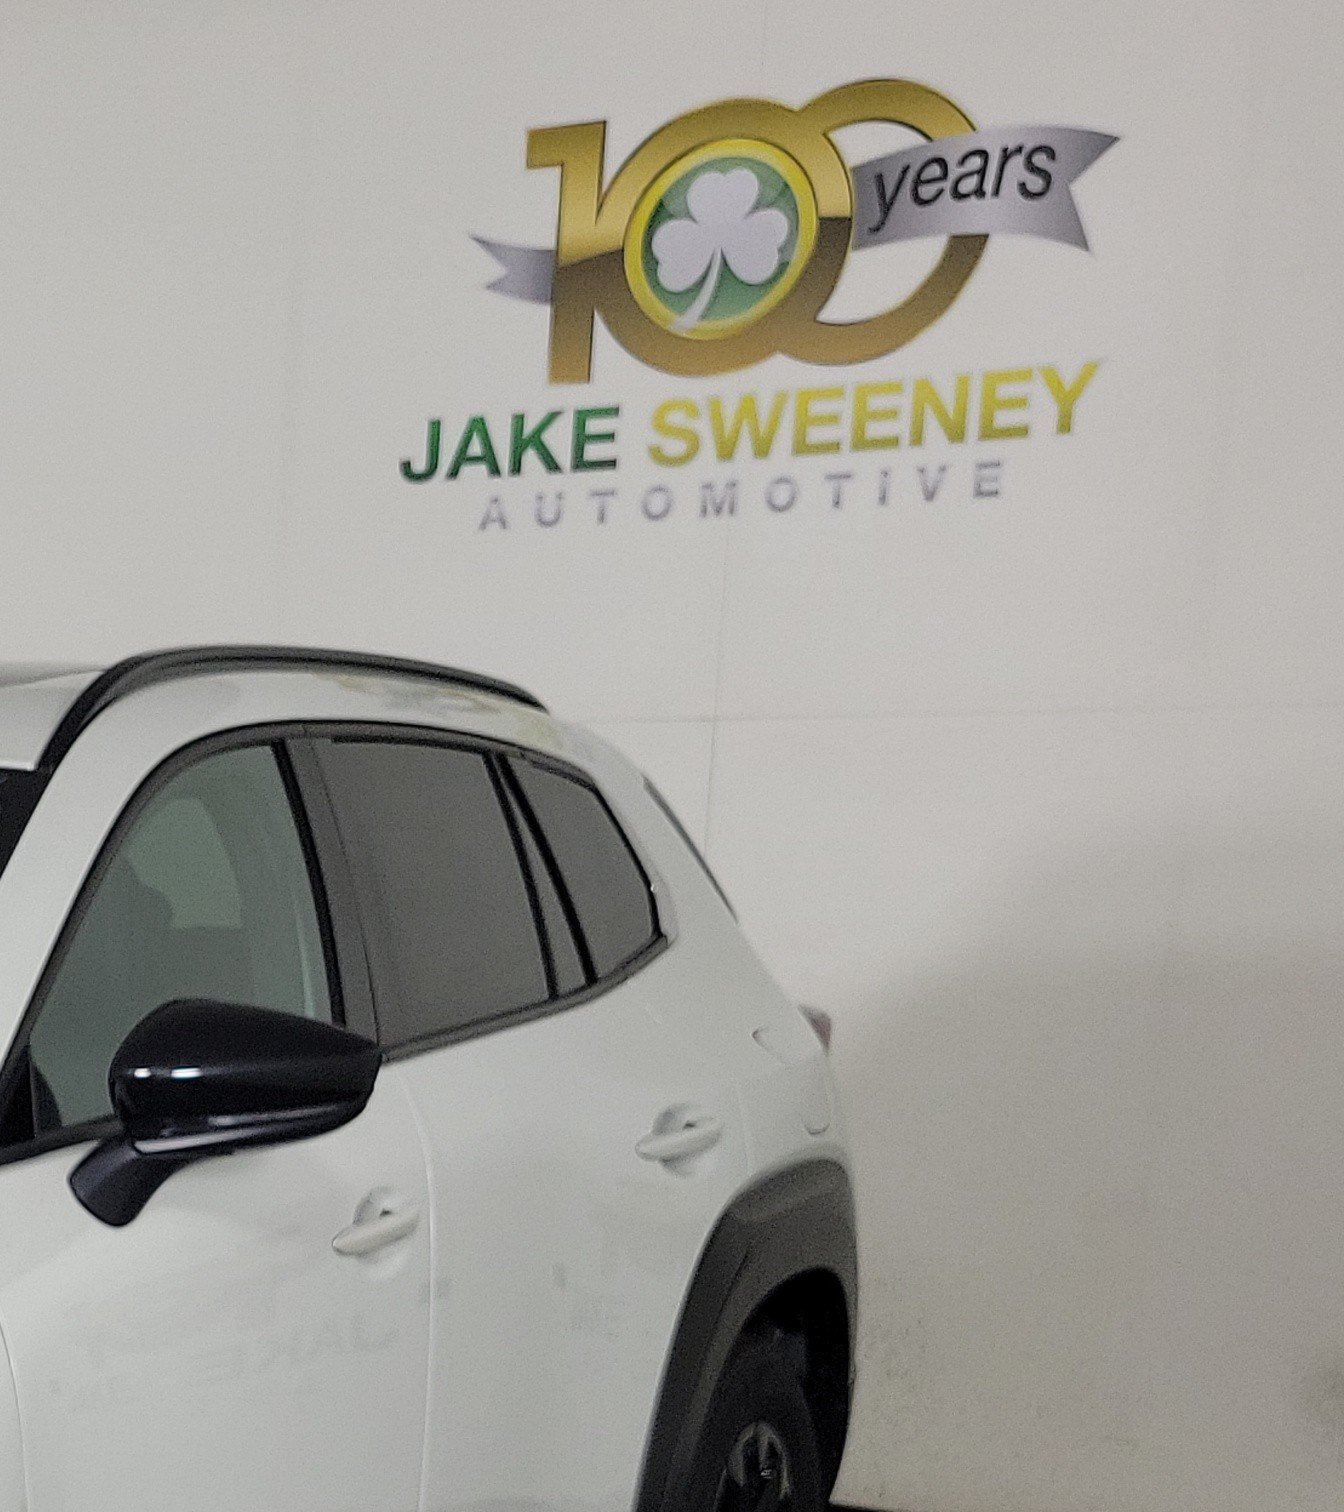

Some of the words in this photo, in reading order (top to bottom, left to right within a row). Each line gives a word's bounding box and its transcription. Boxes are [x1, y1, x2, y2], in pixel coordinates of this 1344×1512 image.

[527, 78, 989, 385] 100
[867, 138, 1058, 234] years
[399, 406, 620, 484] JAKE
[647, 361, 1100, 467] SWEENEY
[477, 461, 1004, 532] AUTOMOTIVE
